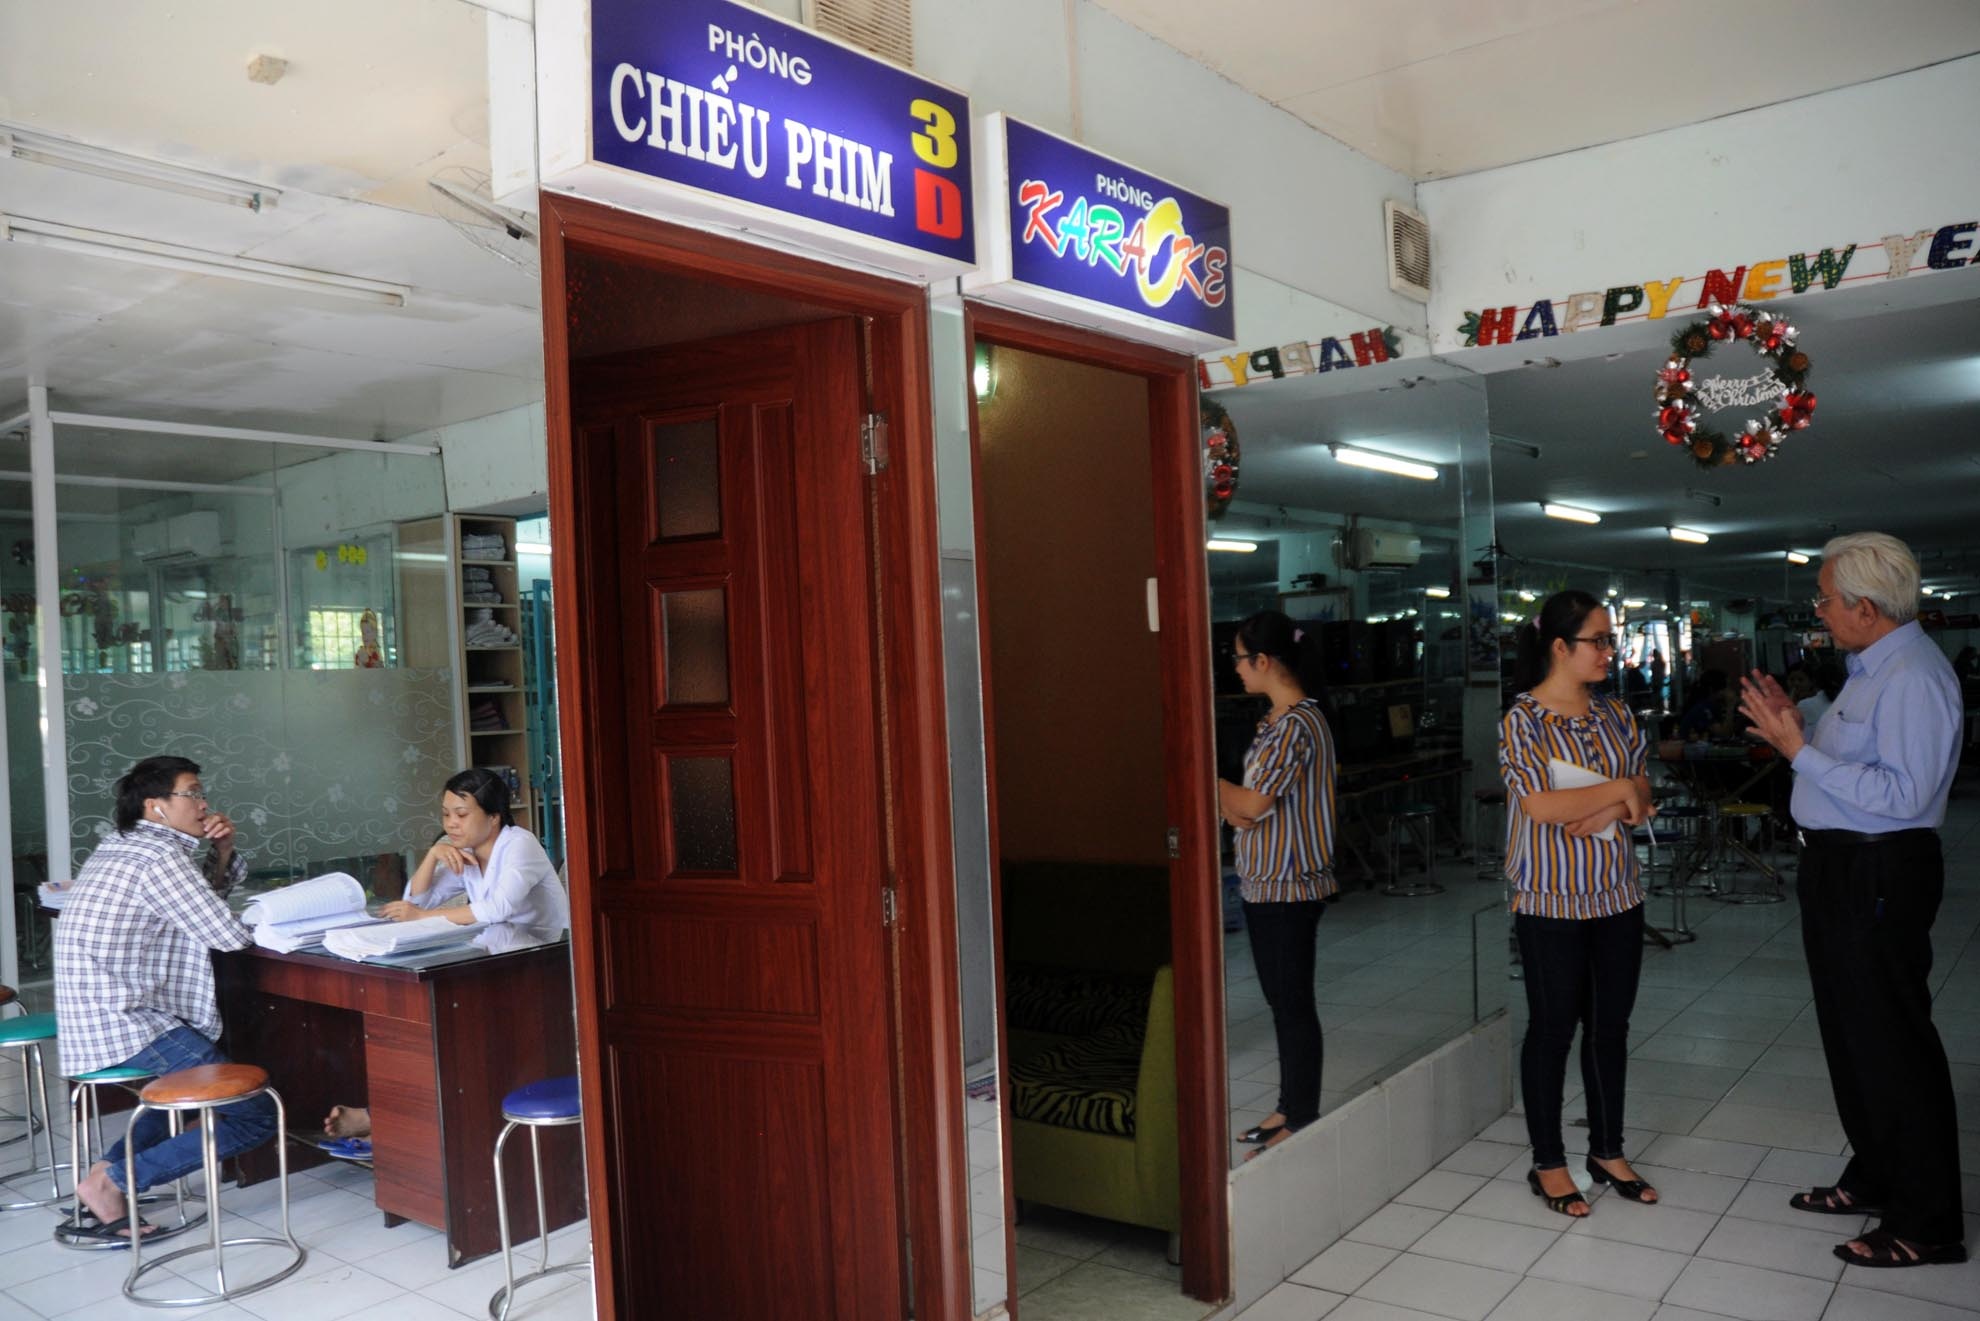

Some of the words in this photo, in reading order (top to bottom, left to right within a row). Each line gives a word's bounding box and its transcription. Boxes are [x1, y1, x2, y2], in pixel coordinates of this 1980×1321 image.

[709, 23, 813, 85] PHÒNG
[609, 63, 770, 179] CHIẾU
[785, 119, 895, 218] PHIM
[1096, 174, 1153, 211] PHÒNG
[1019, 180, 1228, 306] KARAOKE
[1477, 276, 1684, 347] HAPPY
[1697, 243, 1857, 309] NEW
[1880, 220, 1980, 280] YE
[1702, 374, 1750, 397] Merry
